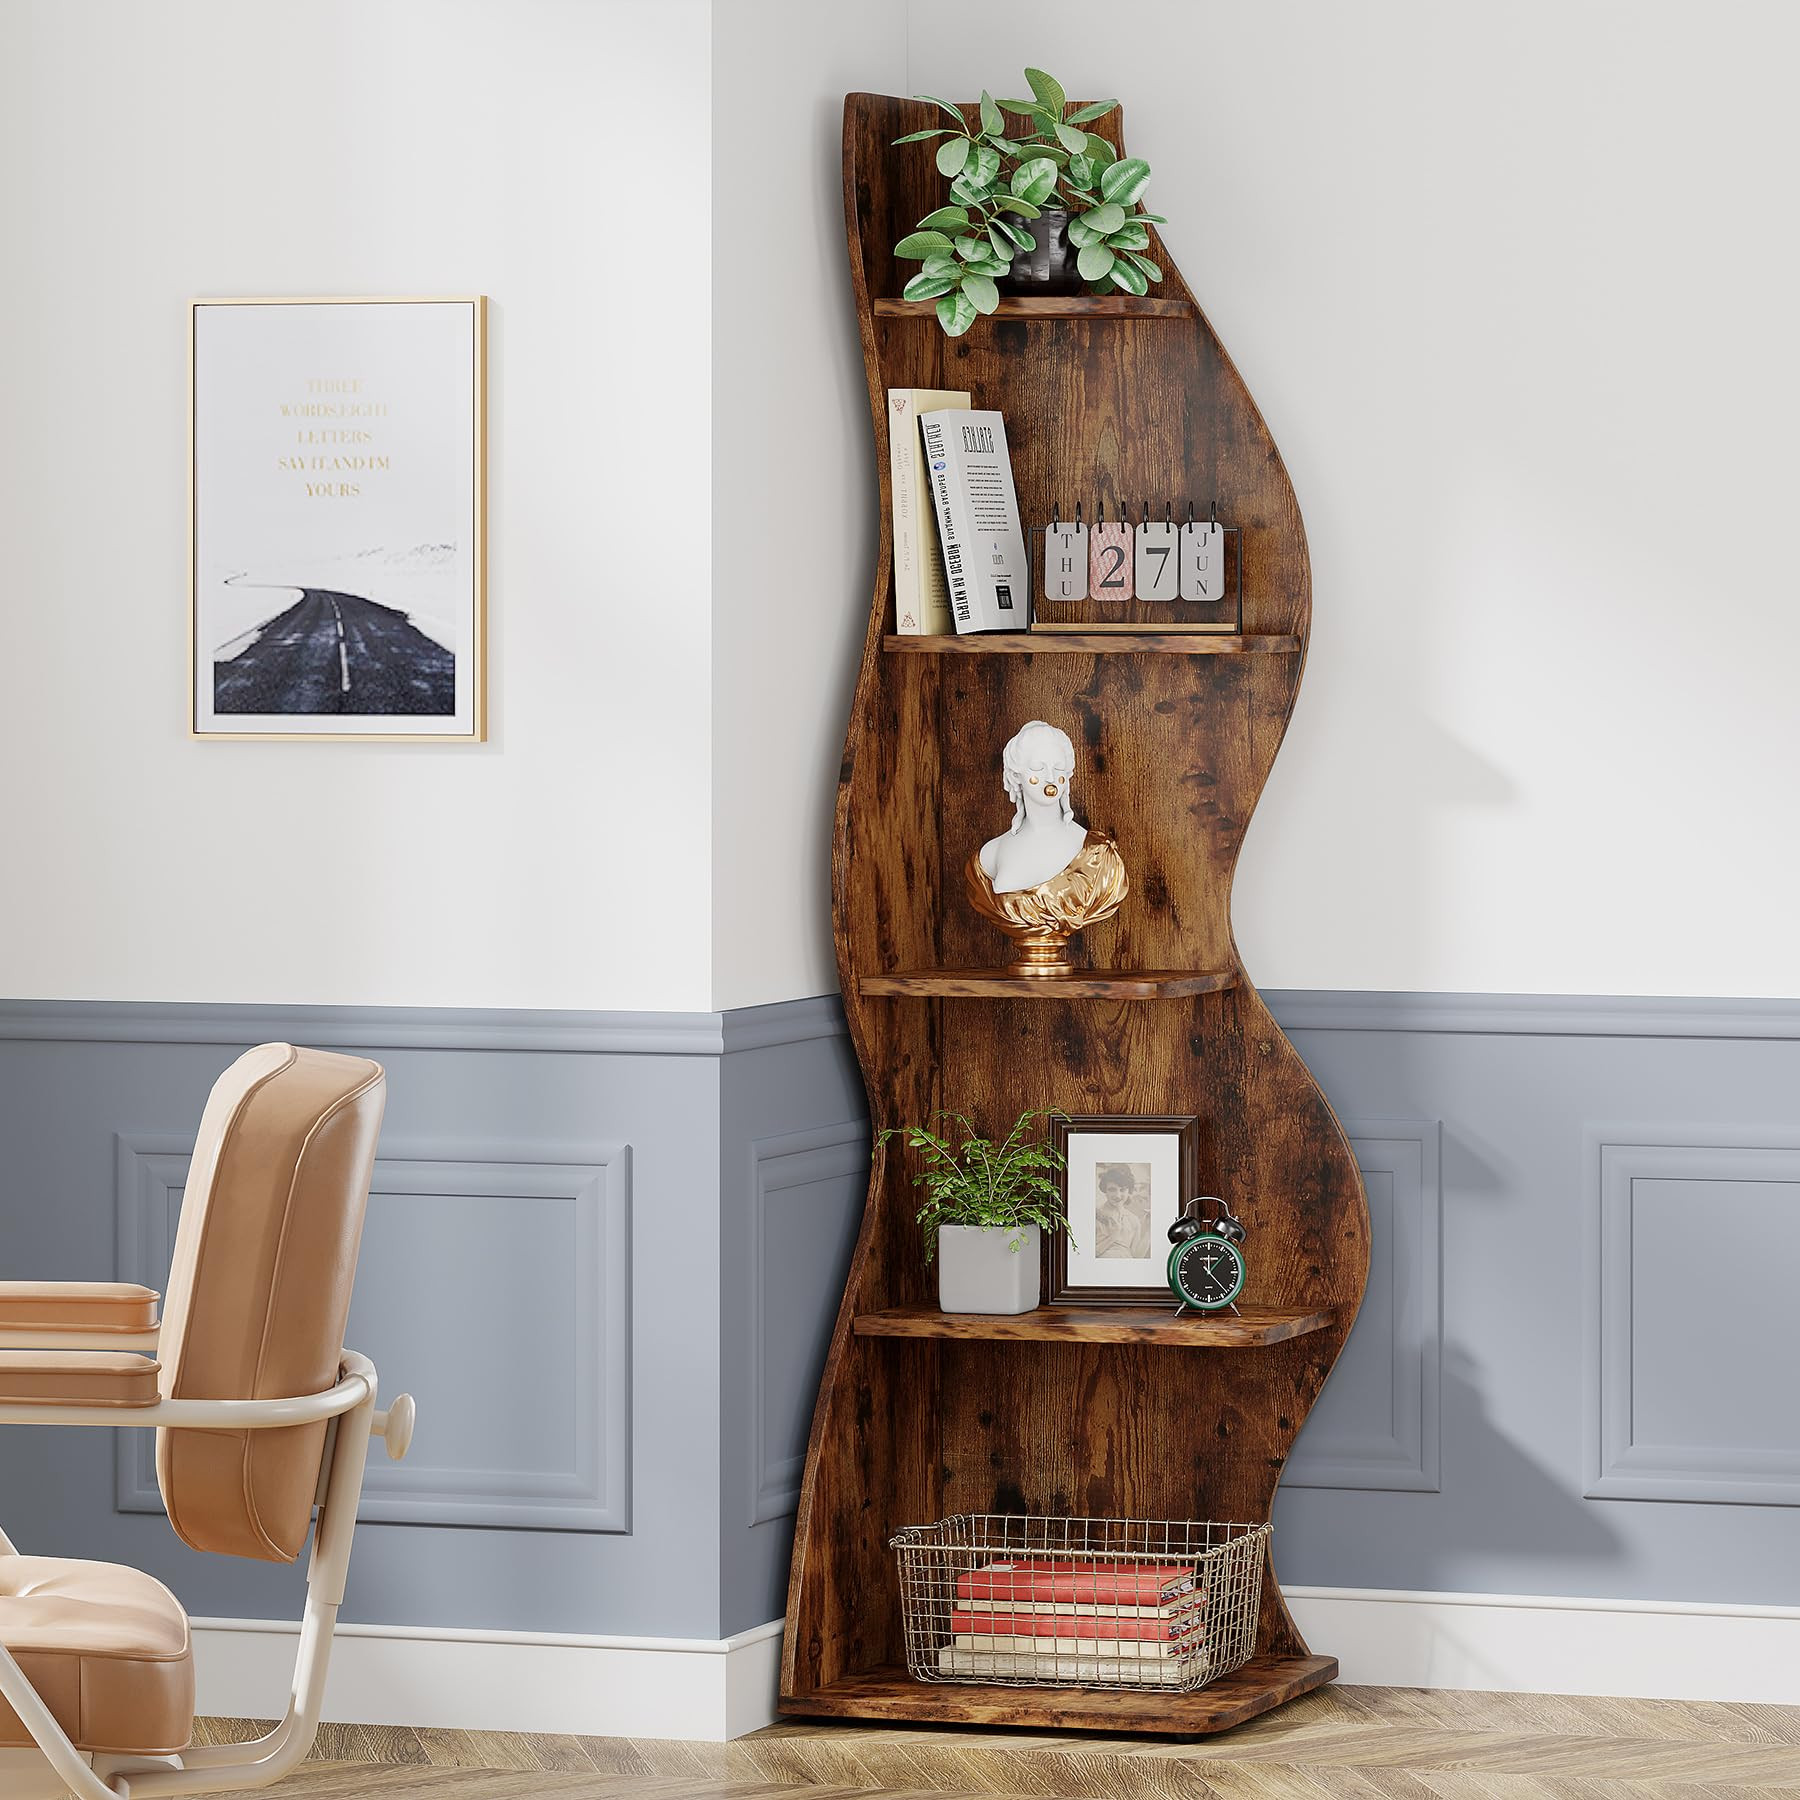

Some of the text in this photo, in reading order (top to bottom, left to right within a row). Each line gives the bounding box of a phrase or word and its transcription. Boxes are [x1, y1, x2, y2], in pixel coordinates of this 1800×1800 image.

[297, 429, 373, 443] LETTERS
[279, 456, 306, 469] SAY
[304, 482, 360, 497] YOURS
